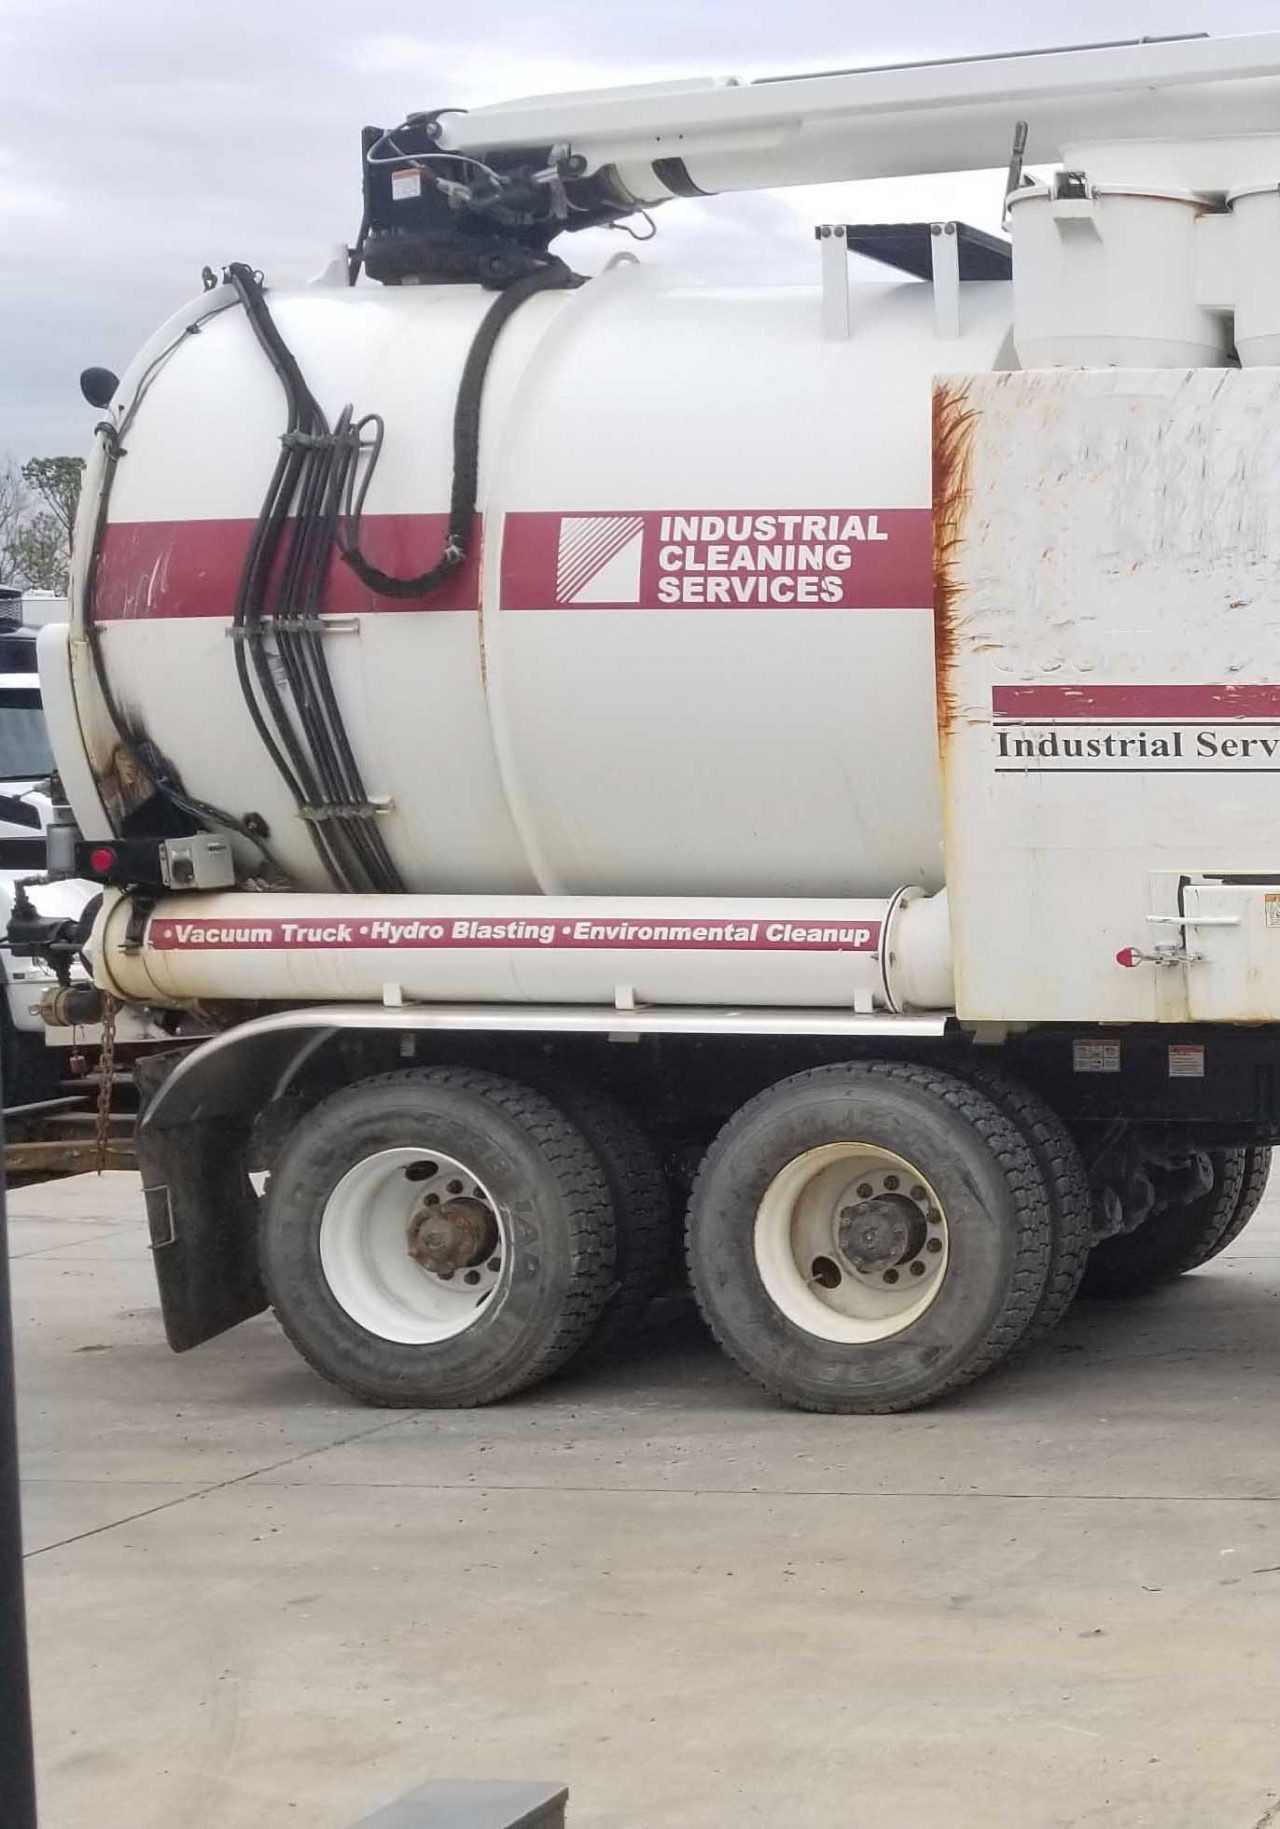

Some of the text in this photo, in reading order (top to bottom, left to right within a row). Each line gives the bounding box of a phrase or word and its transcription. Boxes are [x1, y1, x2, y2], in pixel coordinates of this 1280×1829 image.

[660, 516, 888, 541] INDUSTRIAL
[659, 545, 851, 571] CLEANING
[658, 576, 843, 602] SERVICES
[997, 732, 1183, 758] Industrial
[281, 923, 353, 943] Truck
[452, 921, 555, 943] Blasting
[765, 923, 871, 947] Cleanup
